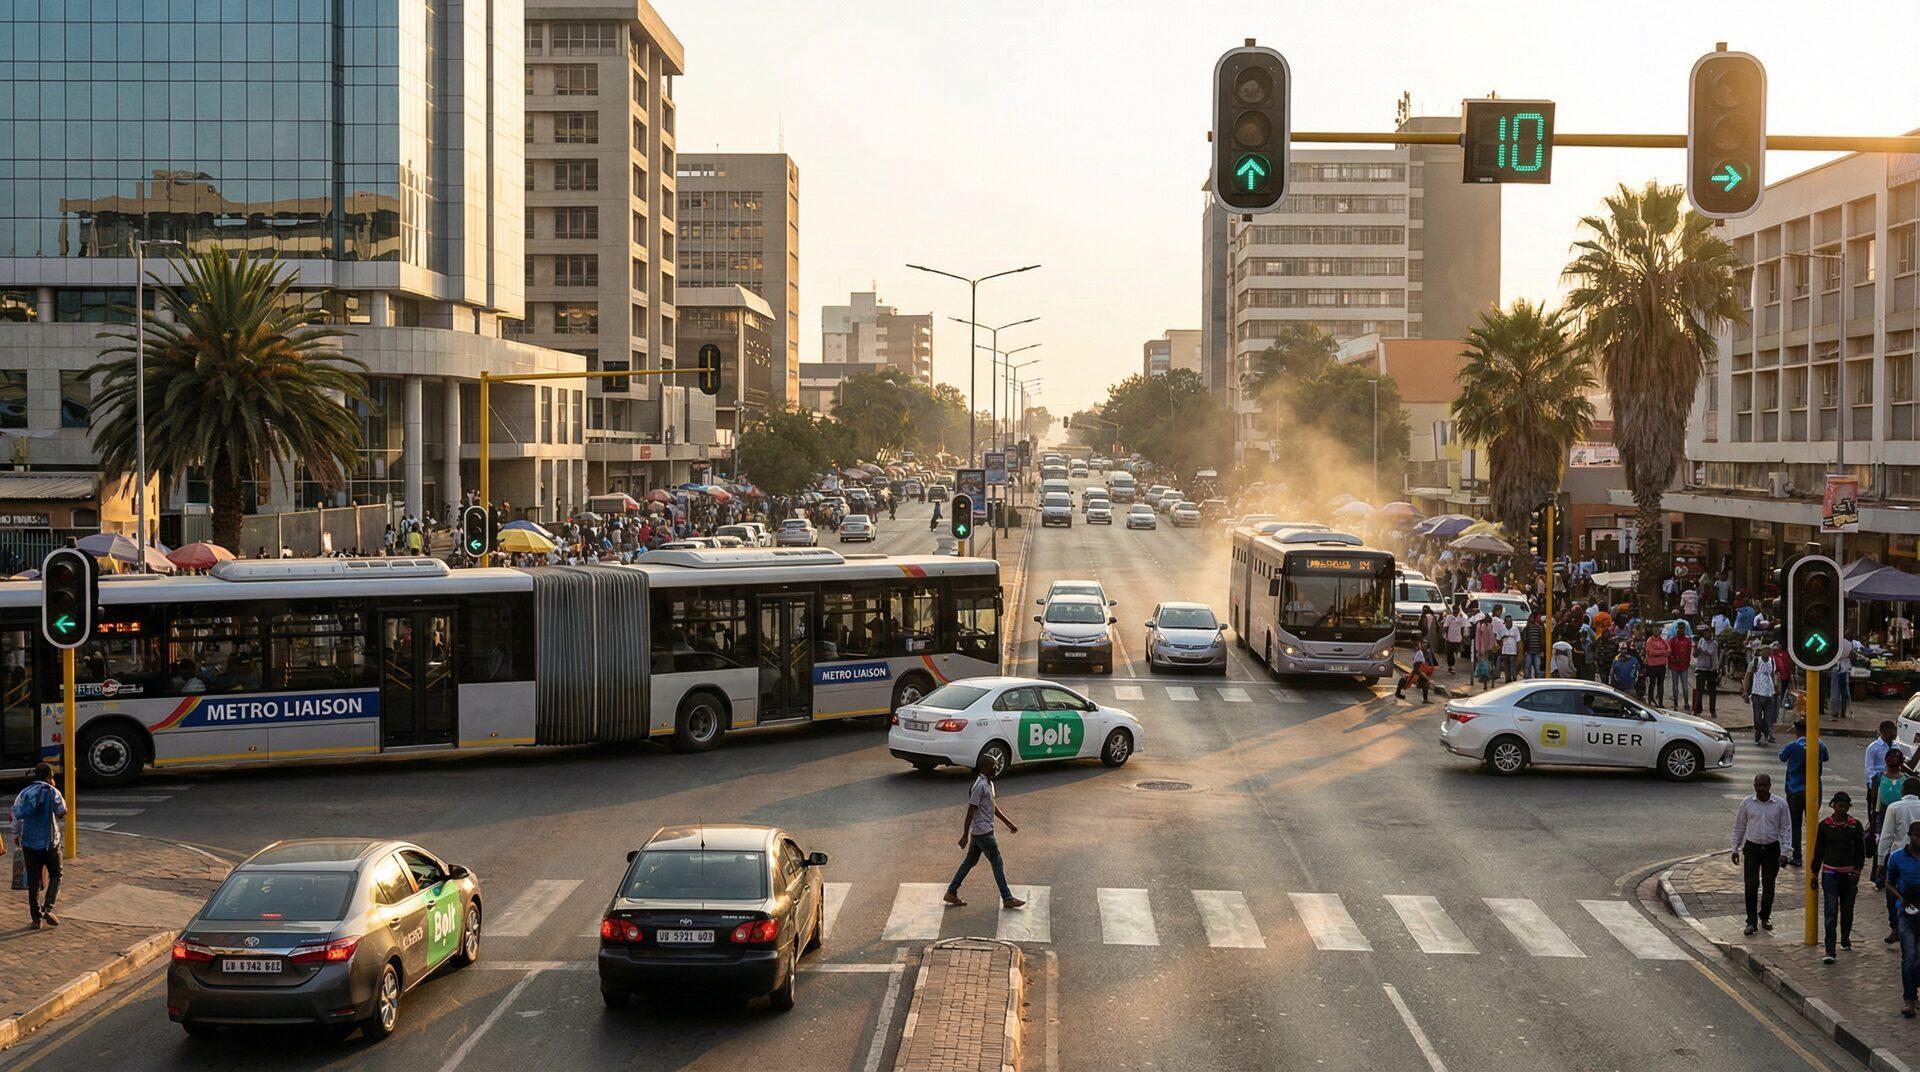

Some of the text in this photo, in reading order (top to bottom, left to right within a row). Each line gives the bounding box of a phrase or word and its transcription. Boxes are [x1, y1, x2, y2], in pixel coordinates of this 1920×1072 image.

[1498, 113, 1544, 172] 10
[822, 667, 887, 681] METRO LIAISON
[207, 697, 363, 721] METRO LIAISON
[1029, 722, 1072, 747] Bolt
[1587, 731, 1643, 747] UBER
[434, 901, 456, 944] Bolt
